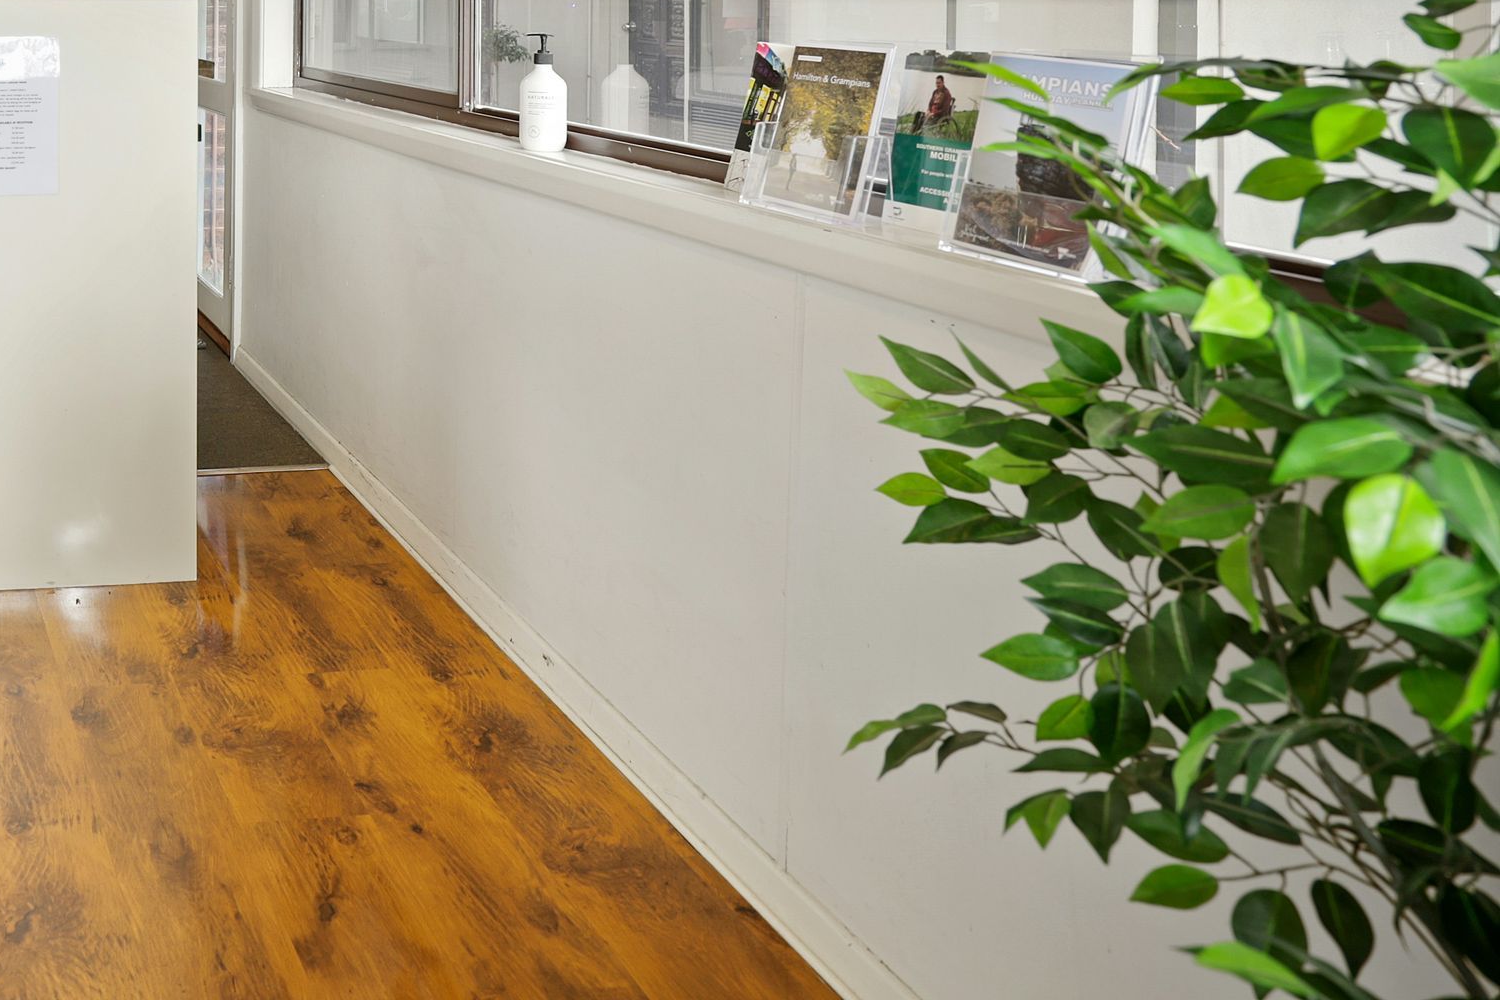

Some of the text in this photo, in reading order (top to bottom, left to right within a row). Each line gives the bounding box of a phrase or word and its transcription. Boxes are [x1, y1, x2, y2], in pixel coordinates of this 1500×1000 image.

[793, 70, 871, 89] Hamilton & Grampians
[993, 74, 1113, 98] MPIANS
